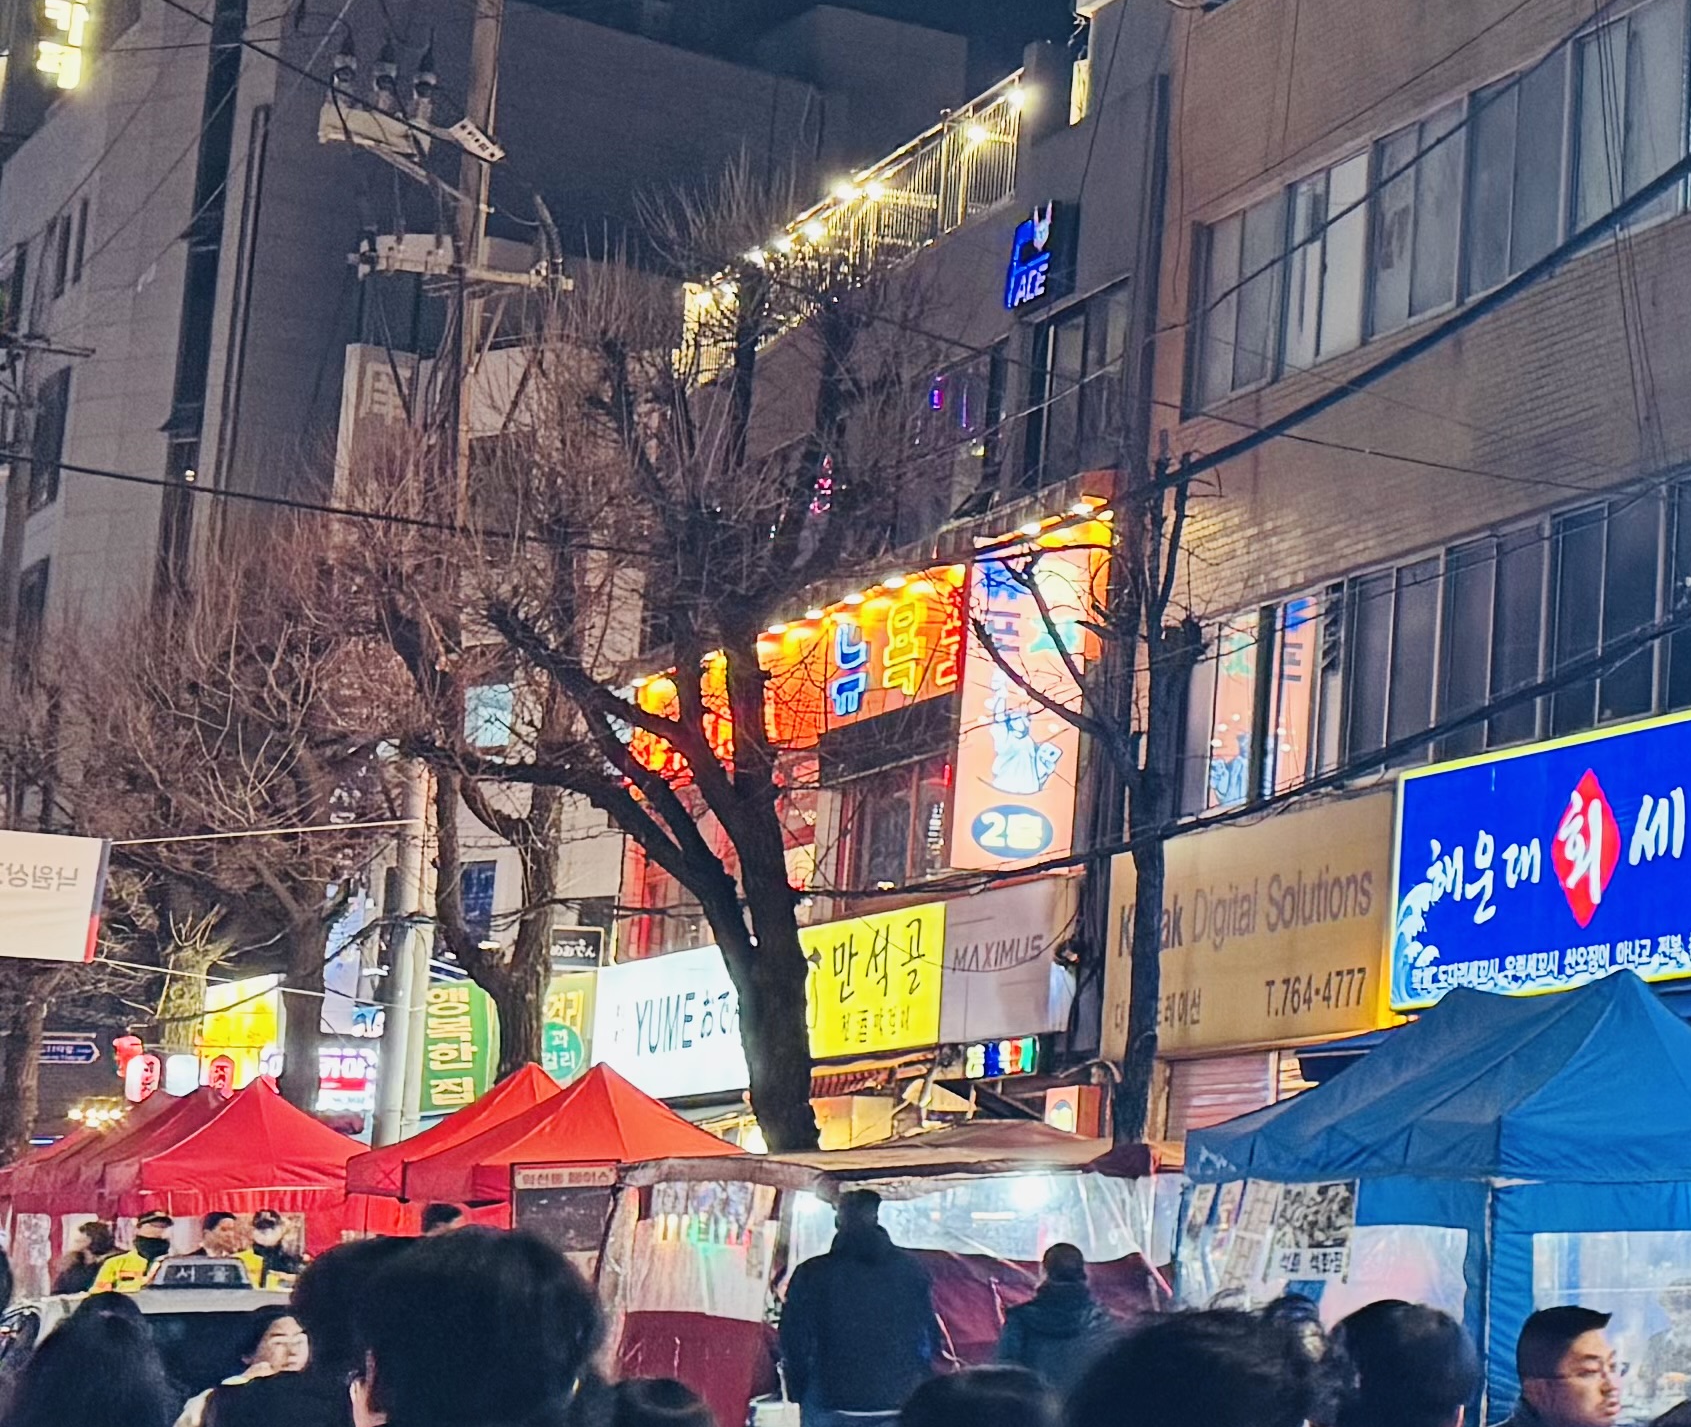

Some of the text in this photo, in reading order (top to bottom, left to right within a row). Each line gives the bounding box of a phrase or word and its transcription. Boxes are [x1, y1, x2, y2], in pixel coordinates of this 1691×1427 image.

[1426, 829, 1541, 925] 해운대
[1556, 789, 1602, 906] 회
[1192, 877, 1259, 952] Digital
[1266, 864, 1374, 933] Solutions
[952, 934, 1044, 972] MAXIMUS
[426, 985, 479, 1072] 행복한
[635, 992, 696, 1056] YUME
[1265, 967, 1367, 1018] T.764-4777
